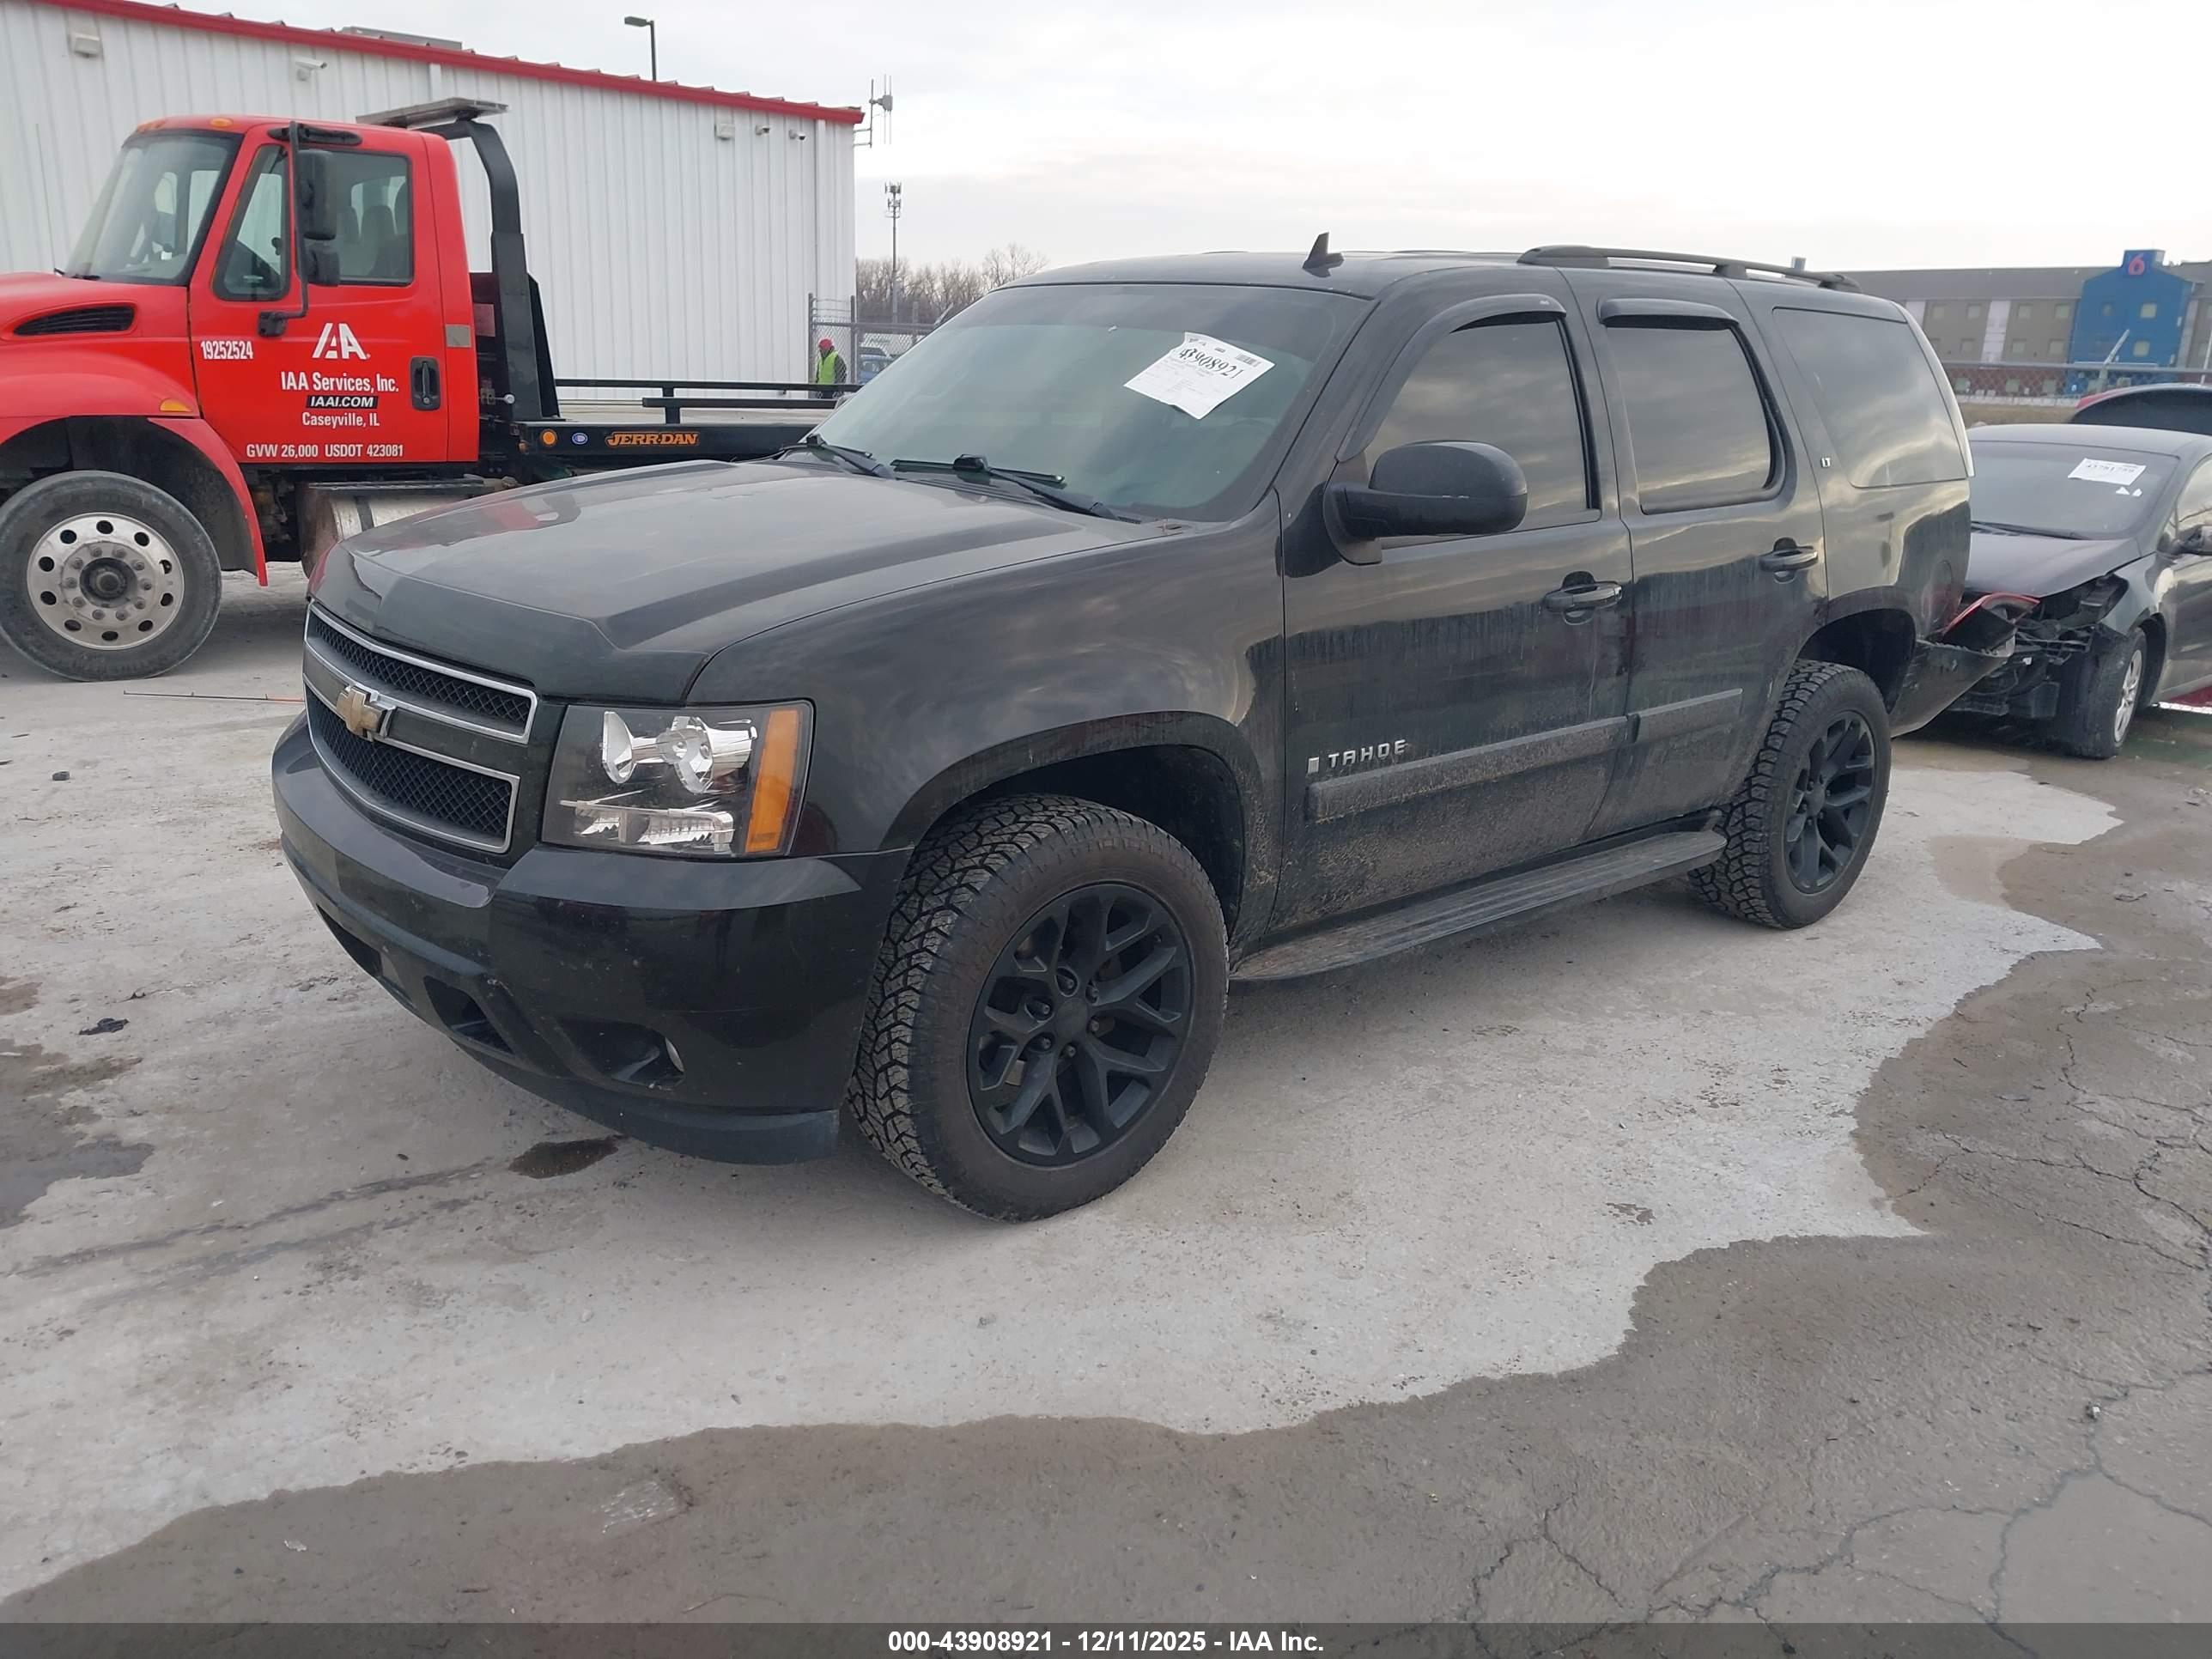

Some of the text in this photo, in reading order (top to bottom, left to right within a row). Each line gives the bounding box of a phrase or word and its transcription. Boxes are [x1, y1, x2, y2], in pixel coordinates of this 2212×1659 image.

[2128, 252, 2145, 276] 6
[200, 340, 253, 360] 19252524
[1178, 346, 1244, 380] 43908921
[281, 371, 399, 393] IAA Services, Inc.
[310, 396, 374, 408] IAAI.COM
[301, 411, 380, 429] Caseyville, IL
[246, 444, 404, 459] GVW 26,000 USDOT 423081
[1820, 457, 1831, 468] LT
[1328, 739, 1407, 768] TAHOE
